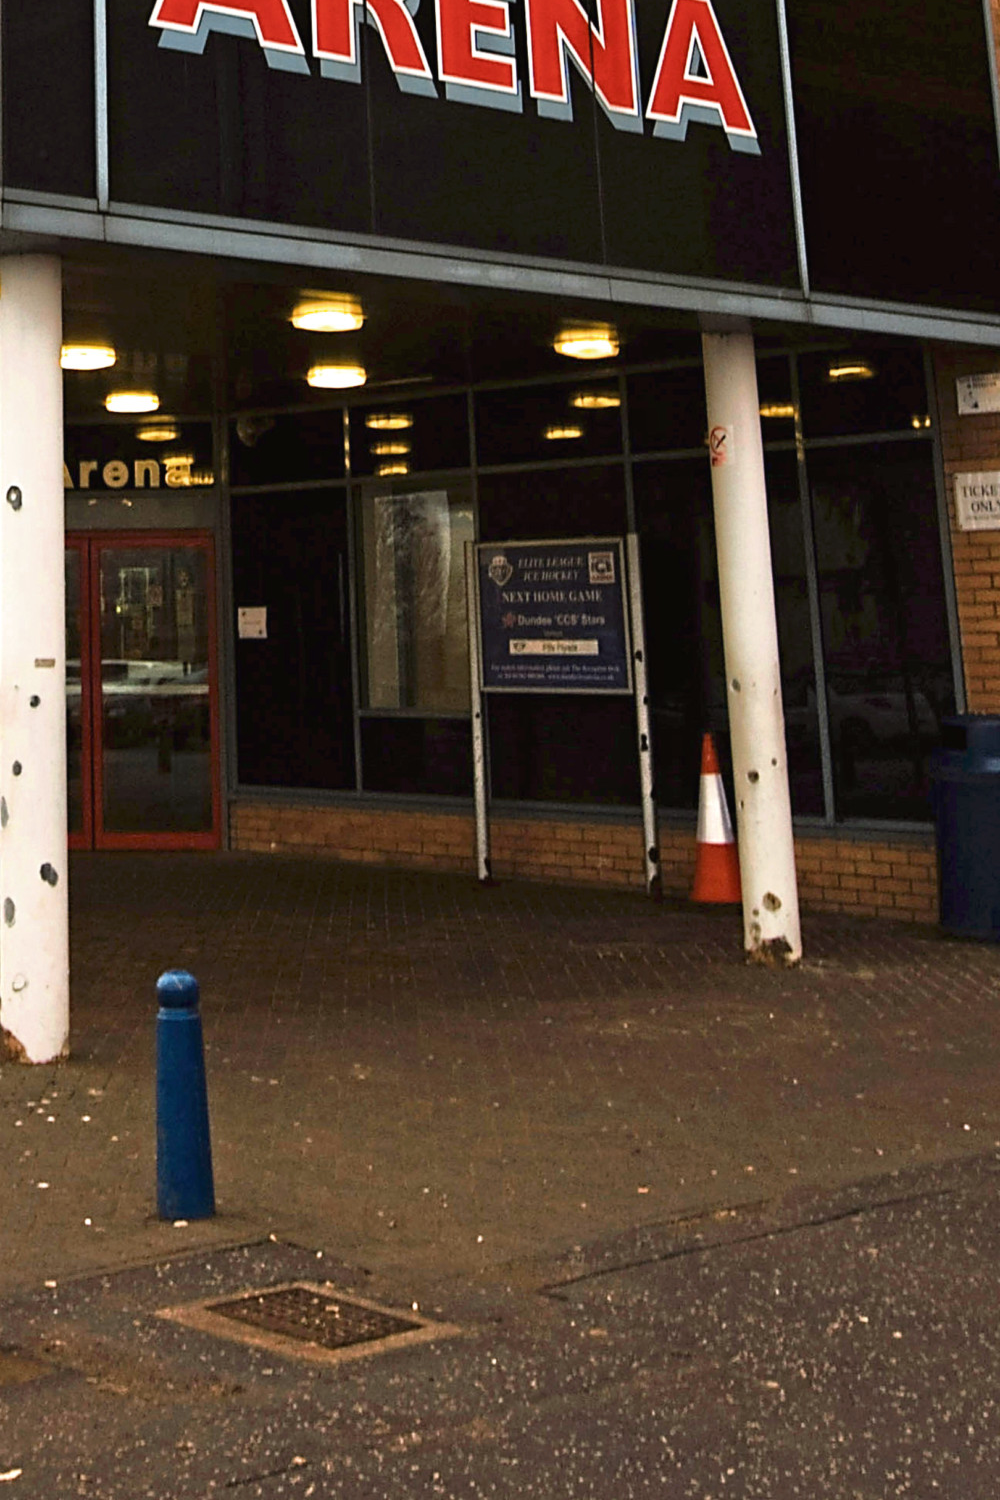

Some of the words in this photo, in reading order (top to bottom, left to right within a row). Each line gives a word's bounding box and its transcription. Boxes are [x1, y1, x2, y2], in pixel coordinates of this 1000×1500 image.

[961, 484, 1000, 498] TICKE
[502, 590, 530, 602] NEXT
[533, 590, 566, 602] HOME
[568, 589, 602, 602] GAME
[517, 613, 553, 626] Dundee
[580, 612, 606, 626] Stars
